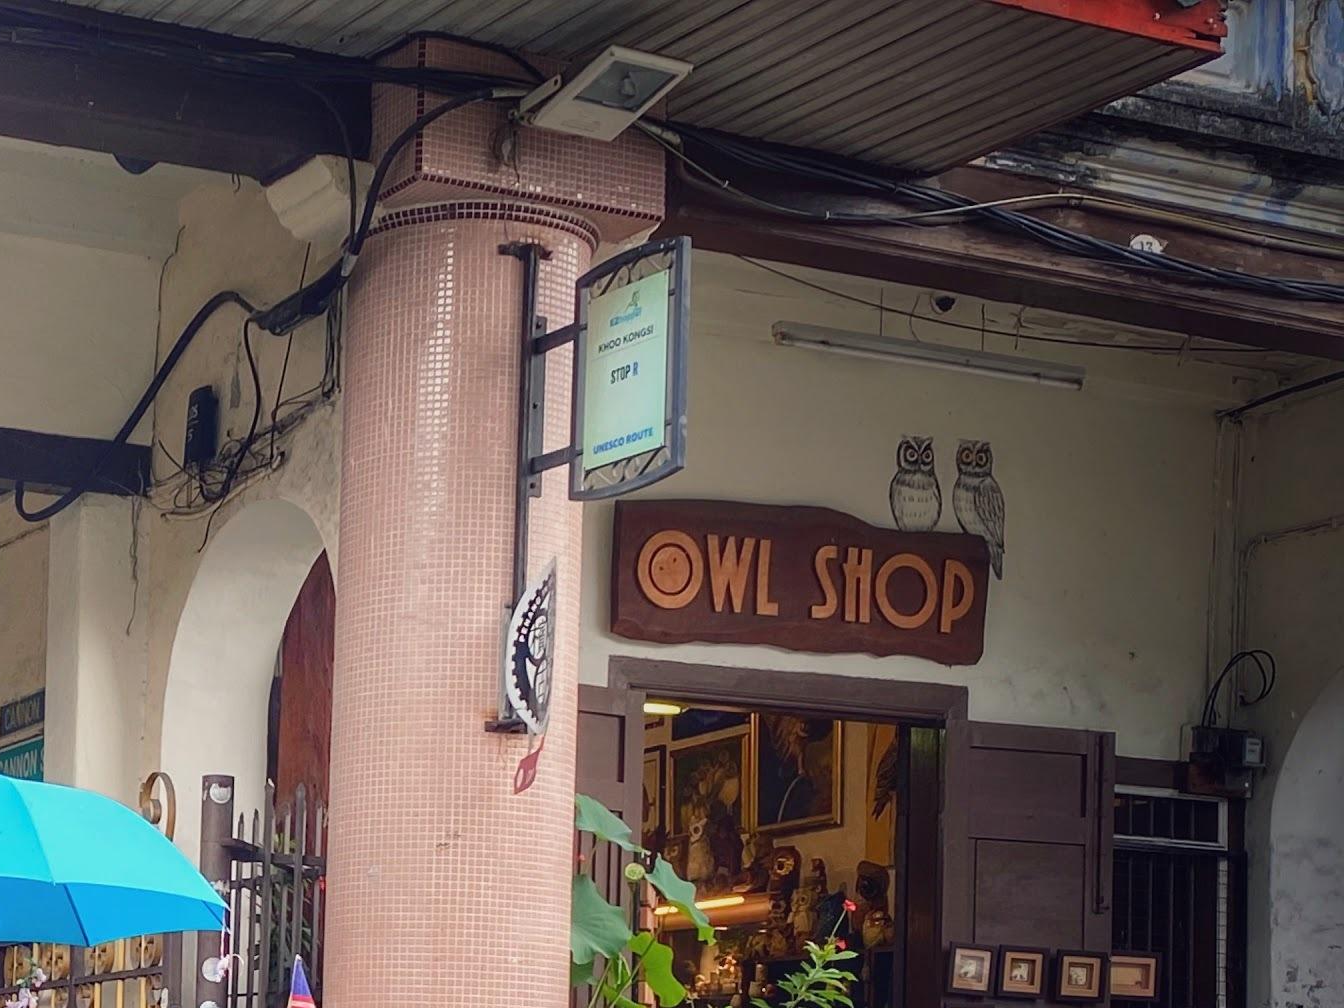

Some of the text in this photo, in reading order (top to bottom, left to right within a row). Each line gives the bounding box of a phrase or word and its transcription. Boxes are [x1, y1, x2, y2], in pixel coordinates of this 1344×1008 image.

[598, 324, 654, 354] KHOO KONGSI
[611, 364, 631, 385] STOP
[593, 427, 653, 454] UNESCO ROUTE
[637, 529, 975, 634] OWL SHOP
